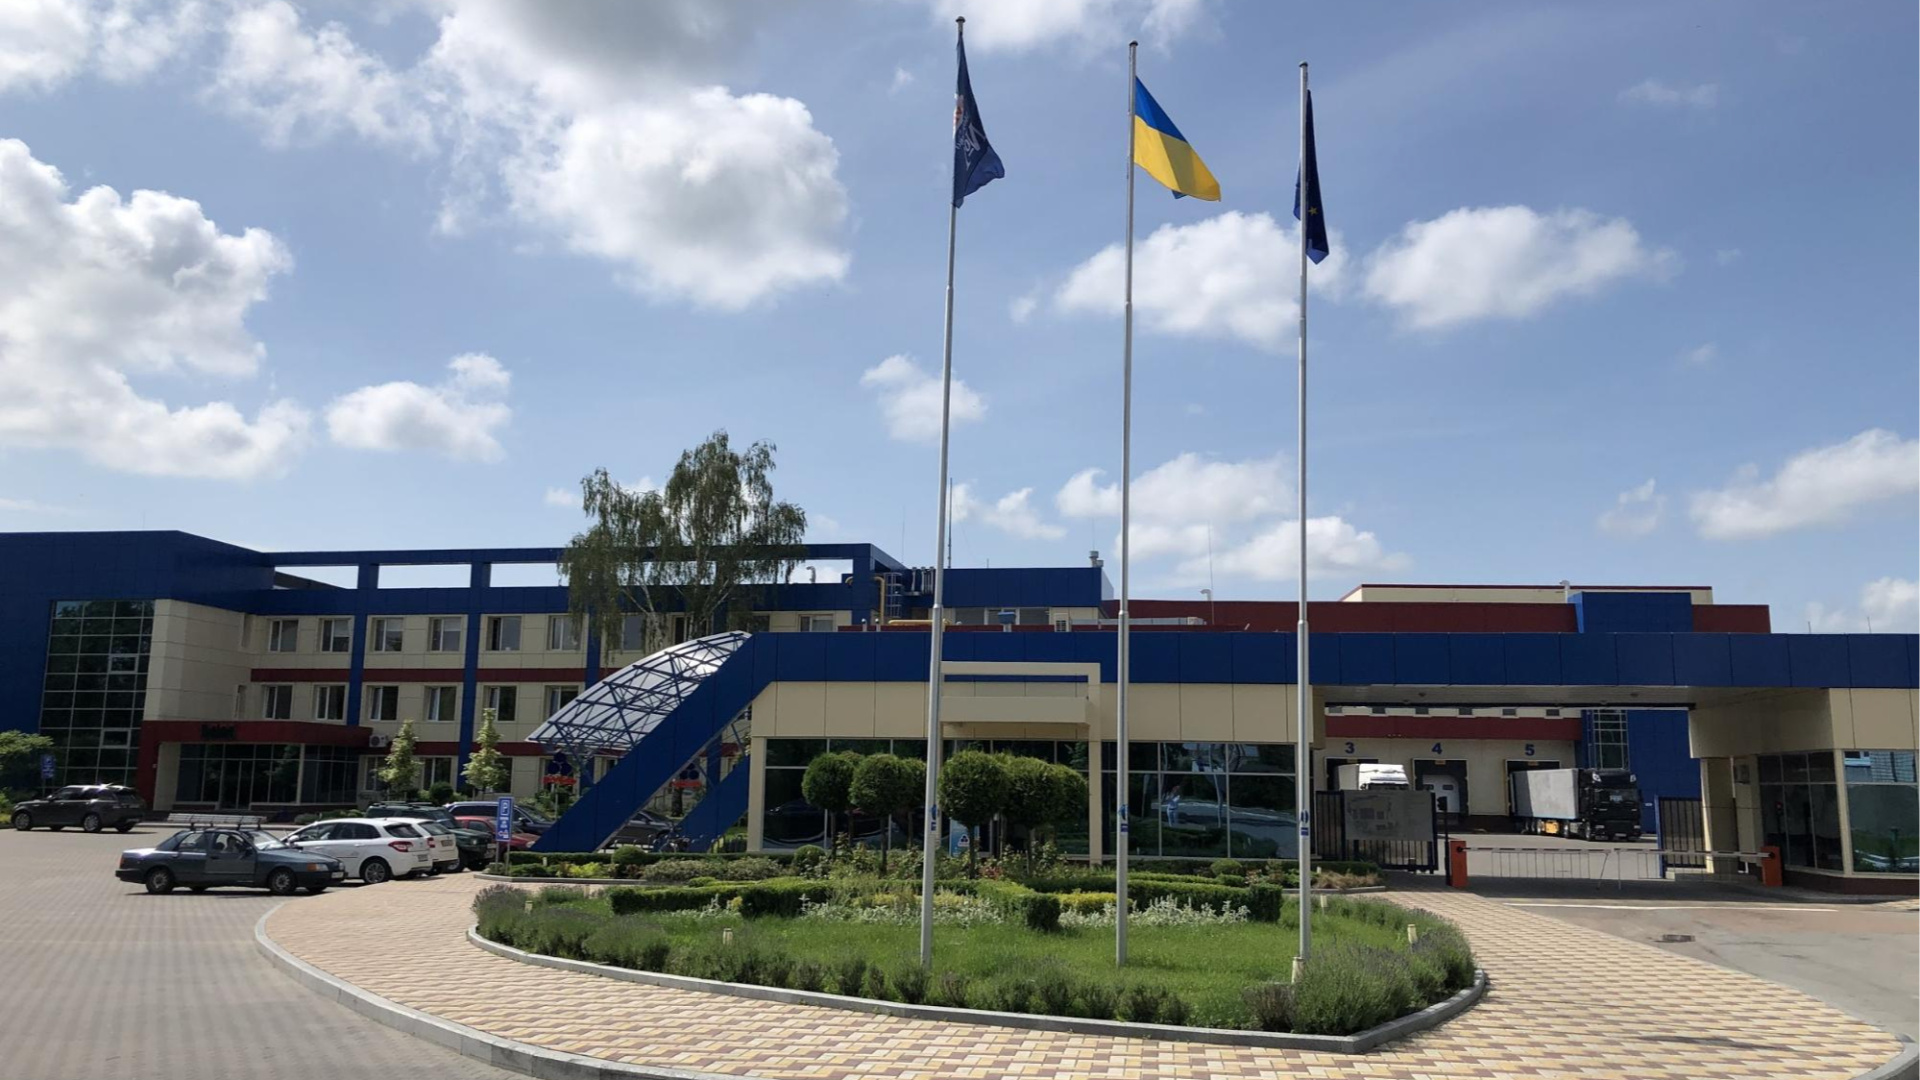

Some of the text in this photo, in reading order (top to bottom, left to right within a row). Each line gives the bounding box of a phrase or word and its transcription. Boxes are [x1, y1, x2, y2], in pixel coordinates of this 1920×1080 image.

[1345, 742, 1355, 754] 3
[1432, 742, 1443, 755] 4
[1525, 743, 1535, 756] 5
